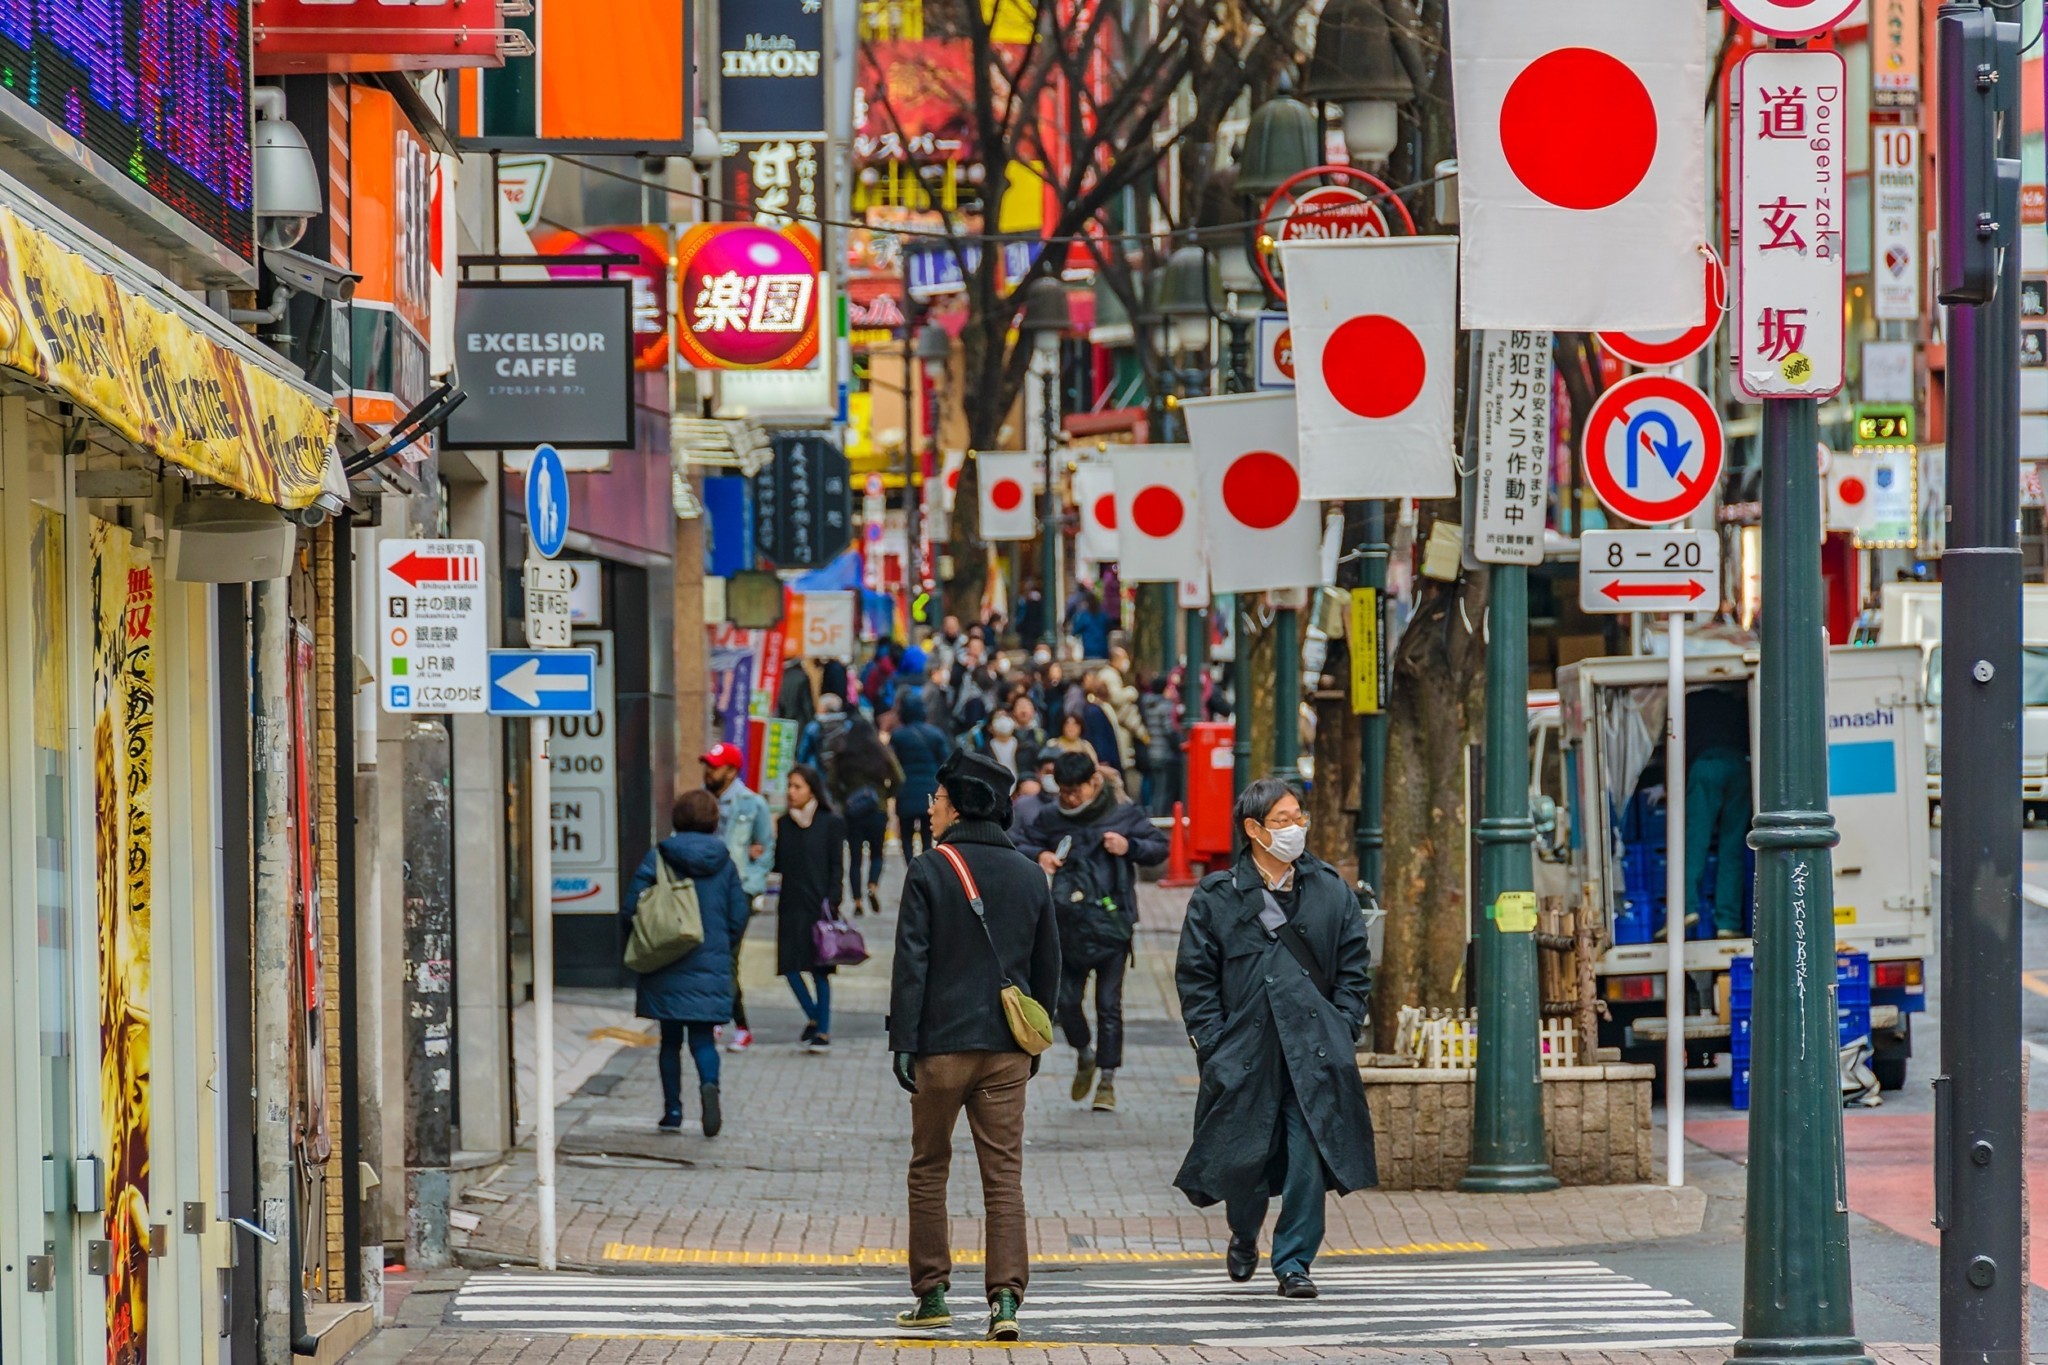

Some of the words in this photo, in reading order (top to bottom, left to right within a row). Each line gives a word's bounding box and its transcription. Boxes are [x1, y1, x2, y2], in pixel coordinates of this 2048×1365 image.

[722, 51, 820, 77] IMON
[1881, 129, 1911, 167] 10
[1810, 86, 1839, 259] Dougen-zaka
[1757, 85, 1808, 363] 道玄坂
[693, 271, 814, 333] 楽園
[467, 333, 605, 352] EXCELSIOR
[495, 353, 577, 377] CAFFÉ
[1505, 331, 1531, 526] 防犯カメラ作動中
[1531, 331, 1548, 507] なさまの安全を守ります
[1494, 546, 1524, 557] Police
[1608, 543, 1623, 567] 8
[1664, 543, 1701, 567] 20
[415, 596, 471, 611] 井の頭線
[415, 626, 458, 641] 銀座線
[809, 618, 845, 646] 5F
[416, 687, 481, 701] バスのりば
[1829, 706, 1893, 729] anashi
[127, 566, 152, 912] 無双であるがために
[550, 803, 581, 819] EN
